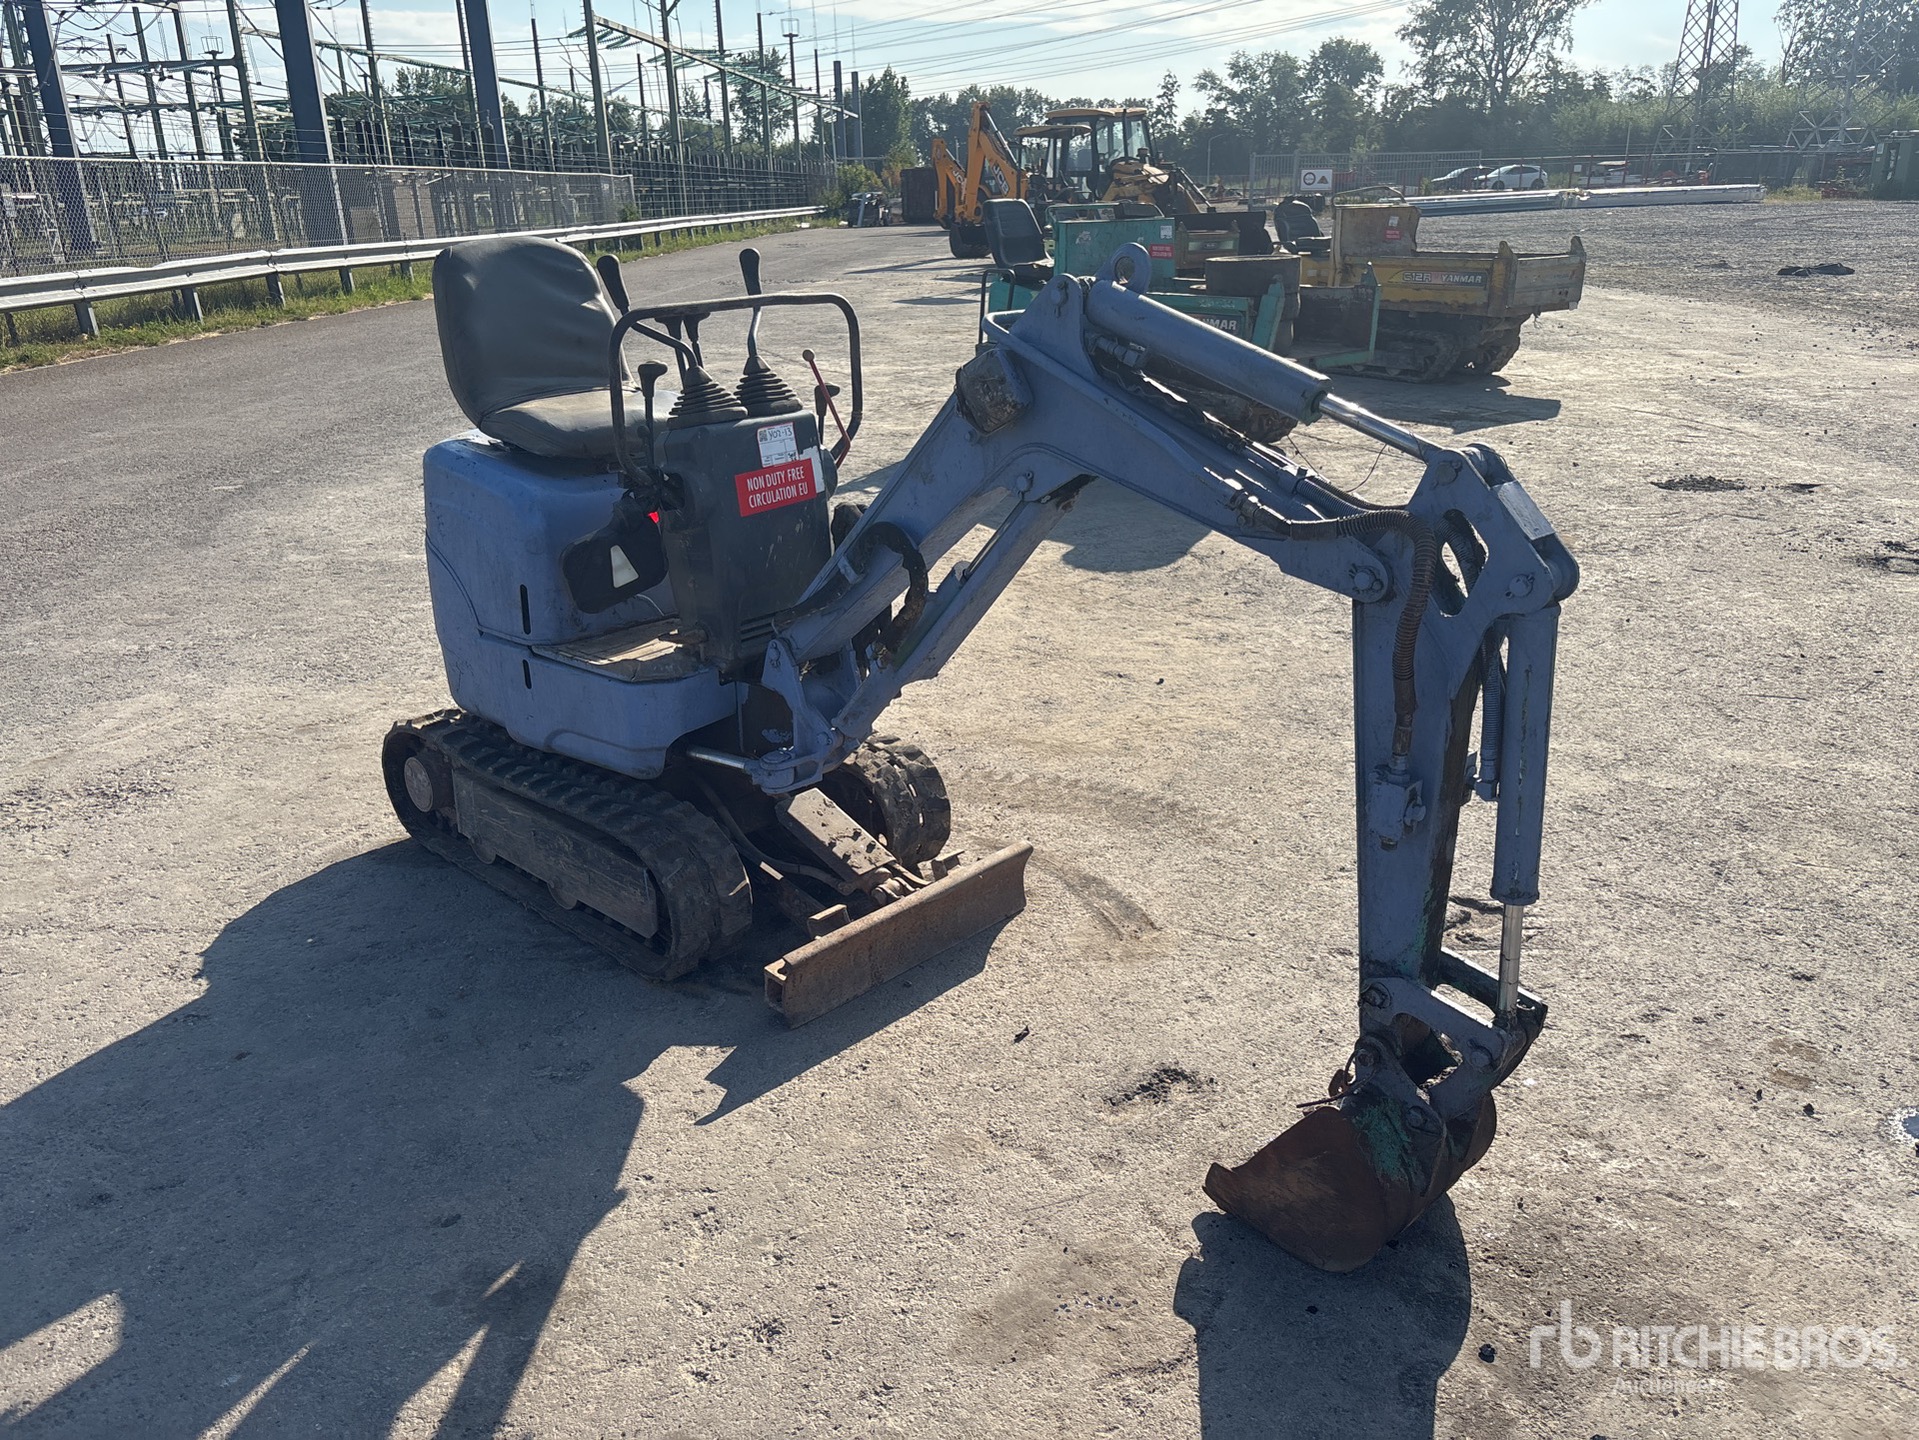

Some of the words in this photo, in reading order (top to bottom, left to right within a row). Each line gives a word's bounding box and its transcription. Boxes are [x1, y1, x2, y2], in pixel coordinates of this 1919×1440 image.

[993, 165, 1009, 195] JCB
[1441, 274, 1482, 283] YANMAR
[747, 475, 765, 491] NON
[765, 471, 785, 487] DUTY
[787, 466, 805, 482] FREE
[748, 485, 797, 508] CIRCULATION
[798, 482, 808, 496] EU
